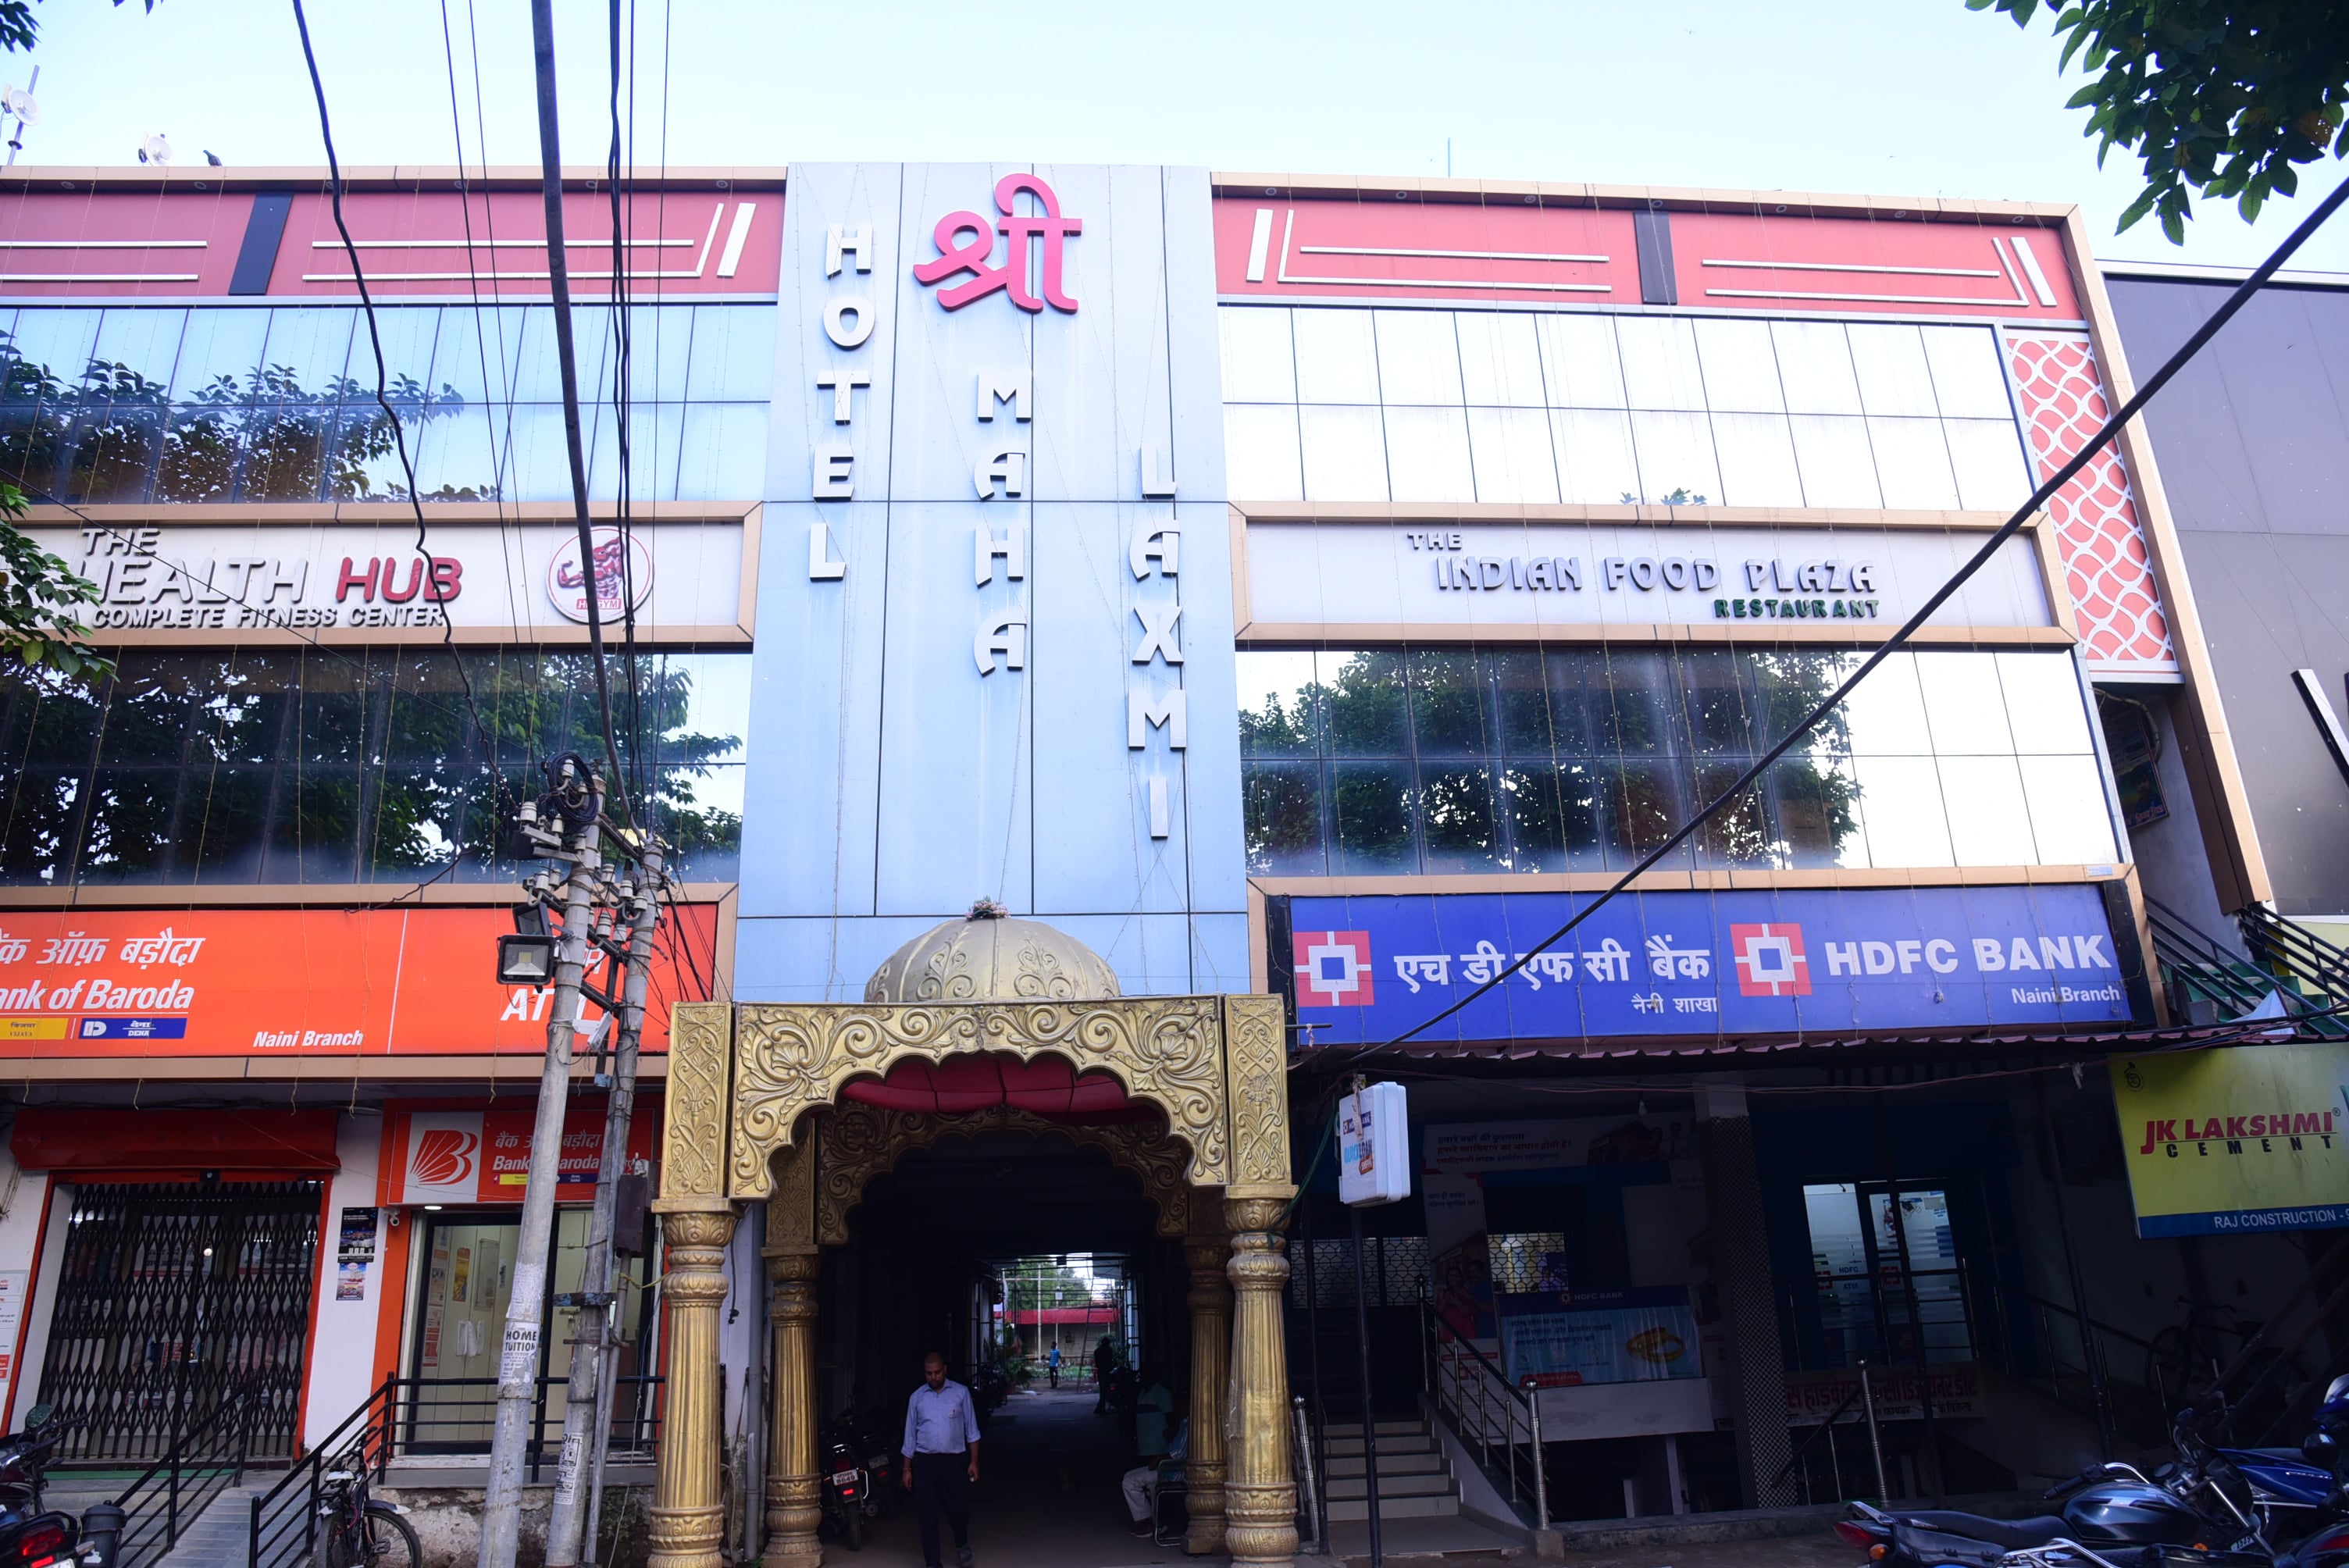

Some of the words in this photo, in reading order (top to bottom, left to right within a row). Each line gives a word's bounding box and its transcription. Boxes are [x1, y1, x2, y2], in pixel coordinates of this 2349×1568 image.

[912, 173, 1082, 315] श्री
[809, 223, 875, 583] HOTEL
[973, 369, 1033, 677] MAHA
[81, 528, 162, 556] THE
[1407, 531, 1463, 550] THE
[67, 557, 310, 604] HEALTH
[336, 556, 464, 603] HUB
[1436, 556, 1583, 591] INDIAN
[1604, 556, 1720, 592] FOOD
[1746, 558, 1877, 593] PLAZA
[93, 606, 225, 629] COMPLETE
[236, 605, 338, 628] FITNESS
[348, 605, 445, 626] CENTER
[1713, 598, 1880, 618] RESTAURANT
[1127, 439, 1187, 841] LAXMI
[119, 926, 207, 970] बड़ौदा
[1824, 938, 1959, 977] HDFC
[1970, 935, 2112, 972] BANK
[1393, 954, 1452, 994] एच
[1460, 939, 1506, 985] डी
[1515, 951, 1574, 992] एफ
[1582, 937, 1631, 982] सी
[1646, 934, 1711, 981] बैंक
[48, 978, 87, 1010] of
[82, 978, 195, 1010] Baroda
[500, 988, 587, 1021] AT
[1631, 992, 1664, 1014] नैनी
[1672, 997, 1718, 1013] शाखा
[2011, 986, 2058, 1005] Naini
[2059, 985, 2121, 1003] Branch
[252, 1031, 299, 1048] Naini
[301, 1030, 365, 1047] Branch
[494, 1131, 520, 1149] बैंक
[2140, 1119, 2177, 1155] JK
[2184, 1111, 2333, 1141] LAKSHMI
[2165, 1135, 2332, 1158] CEMENT
[492, 1155, 531, 1171] Bank
[558, 1153, 601, 1170] aroda
[2213, 1215, 2238, 1228] RAJ
[2241, 1208, 2337, 1228] CONSTRUCTION
[505, 1330, 537, 1342] HOME
